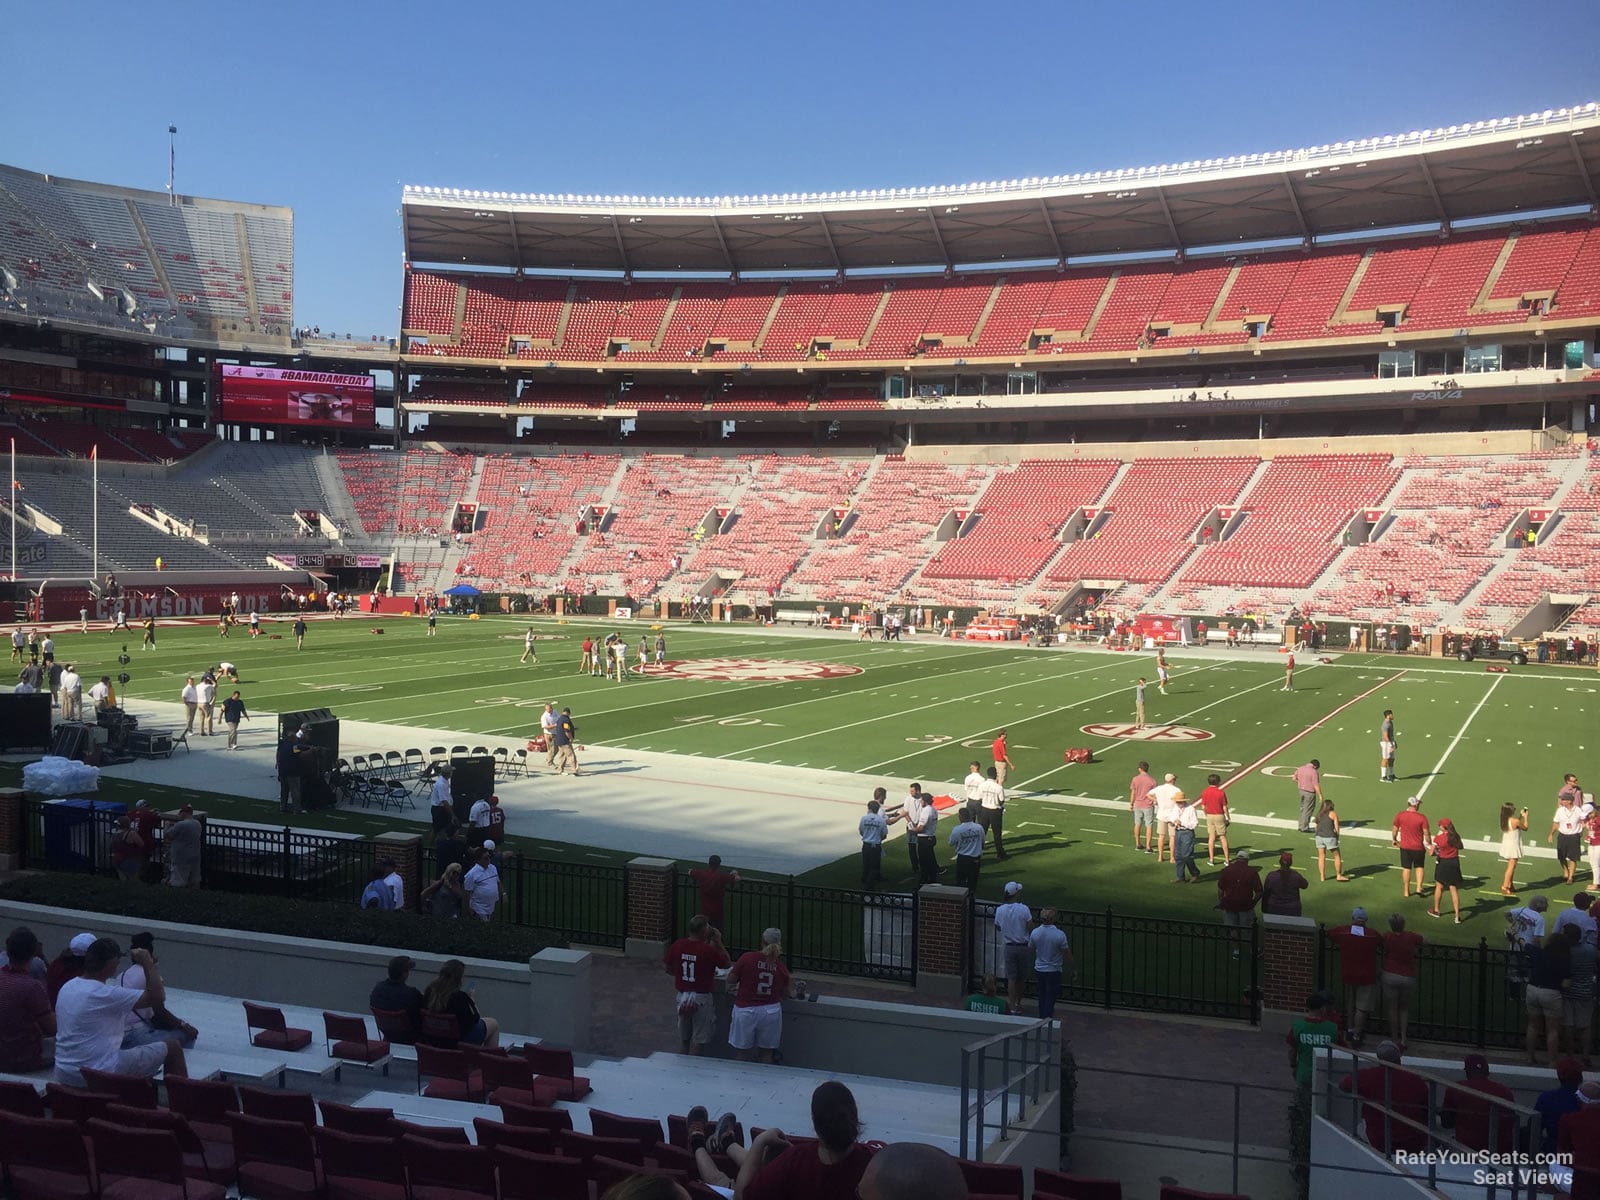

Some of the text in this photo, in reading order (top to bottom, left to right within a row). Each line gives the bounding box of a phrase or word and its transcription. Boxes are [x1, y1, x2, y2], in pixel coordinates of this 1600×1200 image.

[281, 370, 370, 386] #BAMAGAMEDAY
[1411, 390, 1463, 401] RAV4
[1255, 399, 1290, 408] WHEELS
[298, 555, 323, 565] 84:48
[345, 555, 356, 565] 40
[96, 597, 203, 620] CRIMSON
[491, 811, 502, 824] 15
[682, 961, 696, 982] 11
[757, 972, 774, 995] 2
[971, 1001, 999, 1014] USHER
[1300, 1033, 1331, 1045] USHER
